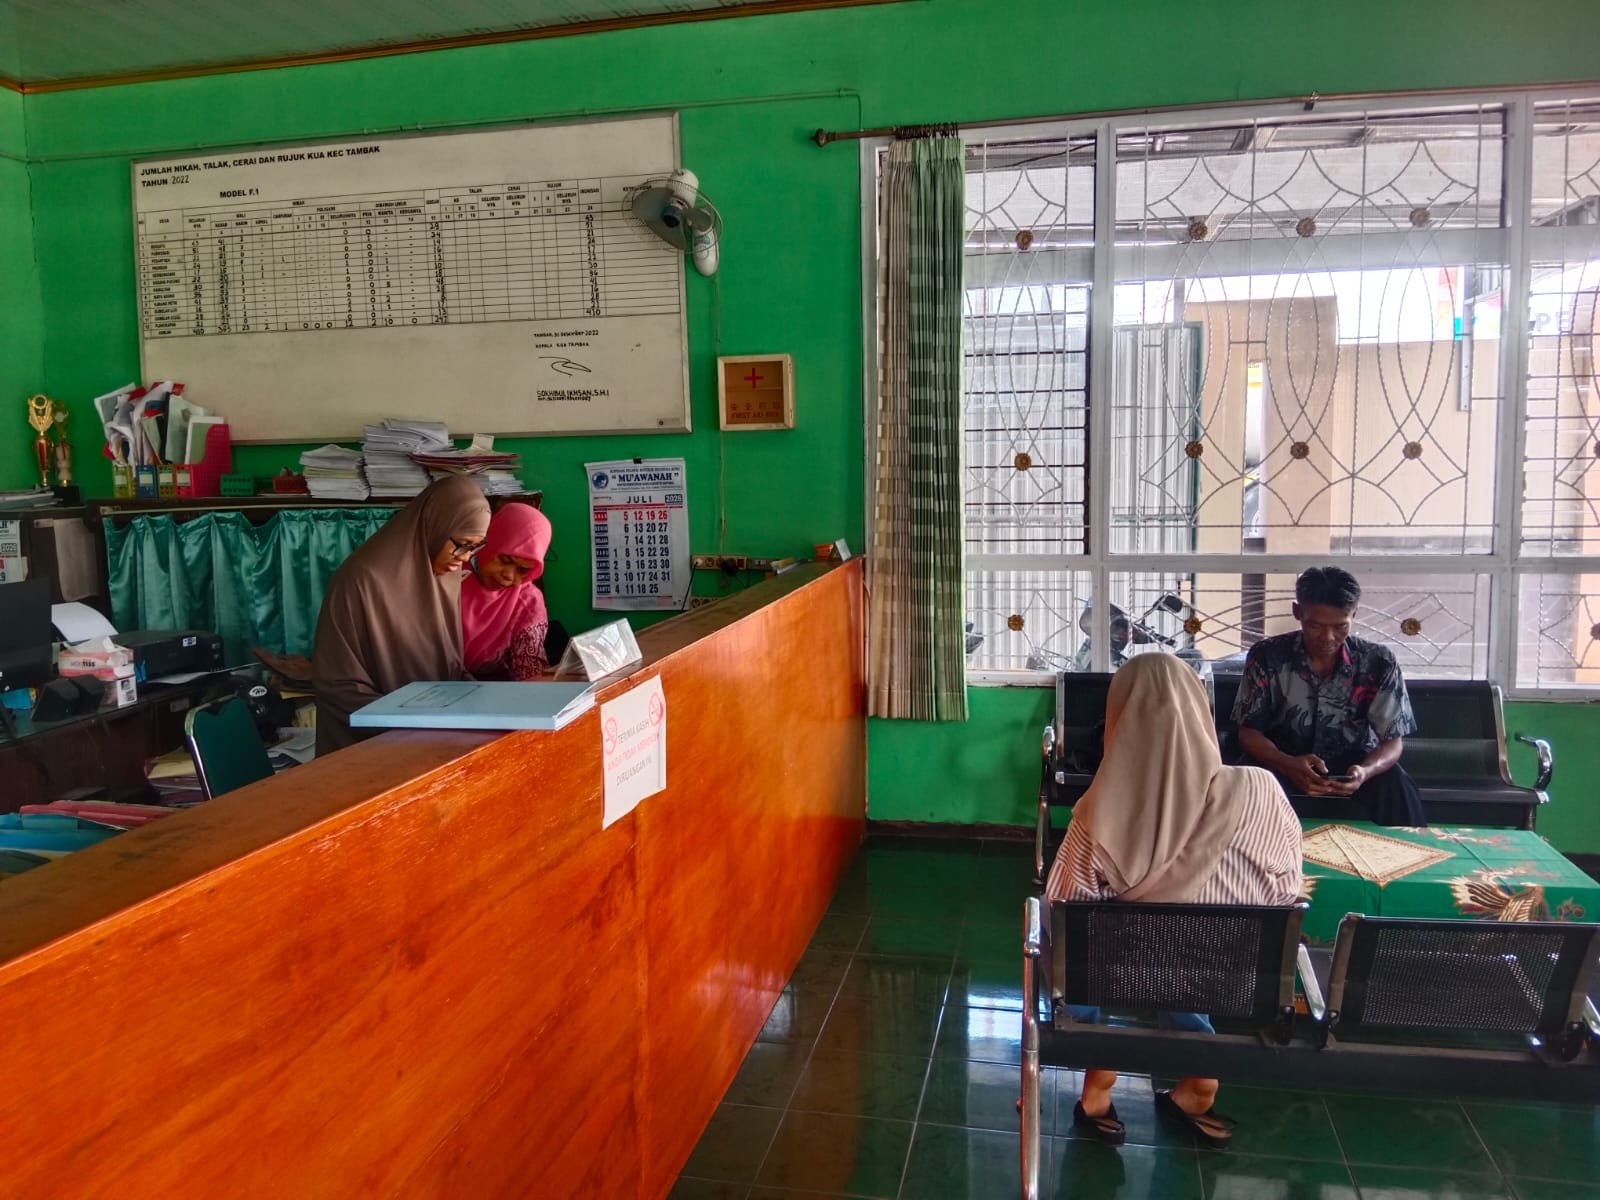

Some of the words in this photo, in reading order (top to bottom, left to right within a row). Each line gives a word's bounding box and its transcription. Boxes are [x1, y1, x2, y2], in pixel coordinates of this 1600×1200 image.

[140, 166, 172, 176] JUMLAH
[174, 163, 201, 173] NIKAH,
[203, 160, 231, 170] TALAK,
[233, 158, 257, 166] CERAI
[258, 156, 276, 164] DAN
[277, 153, 305, 162] RUJUK
[307, 151, 325, 160] KUA
[327, 150, 343, 158] KEC
[346, 146, 380, 157] TAMBAK
[142, 178, 168, 187] TAHUN
[172, 175, 189, 184] 2022
[220, 190, 247, 198] MODEL
[618, 472, 672, 482] MU'AWANAH
[627, 496, 652, 504] JULI
[624, 512, 628, 520] 5
[634, 512, 643, 520] 12
[646, 512, 655, 520] 19
[658, 511, 668, 520] 26
[624, 524, 629, 533] 6
[634, 524, 643, 532] 13
[646, 524, 656, 532] 20
[659, 523, 668, 532] 27
[625, 536, 629, 544] 7
[635, 536, 644, 544] 14
[647, 536, 656, 544] 21
[659, 535, 668, 544] 28
[614, 549, 618, 557] 1
[625, 549, 630, 557] 8
[636, 548, 644, 556] 15
[648, 548, 656, 556] 22
[660, 547, 669, 556] 29
[614, 561, 618, 570] 2
[626, 561, 630, 569] 9
[636, 560, 645, 569] 16
[648, 560, 657, 568] 23
[661, 560, 670, 568] 30
[614, 573, 619, 581] 3
[624, 573, 633, 581] 10
[636, 573, 646, 581] 17
[649, 572, 658, 581] 24
[662, 572, 670, 580] 31
[615, 585, 619, 594] 4
[626, 585, 633, 594] 11
[637, 585, 646, 593] 18
[649, 584, 658, 593] 25
